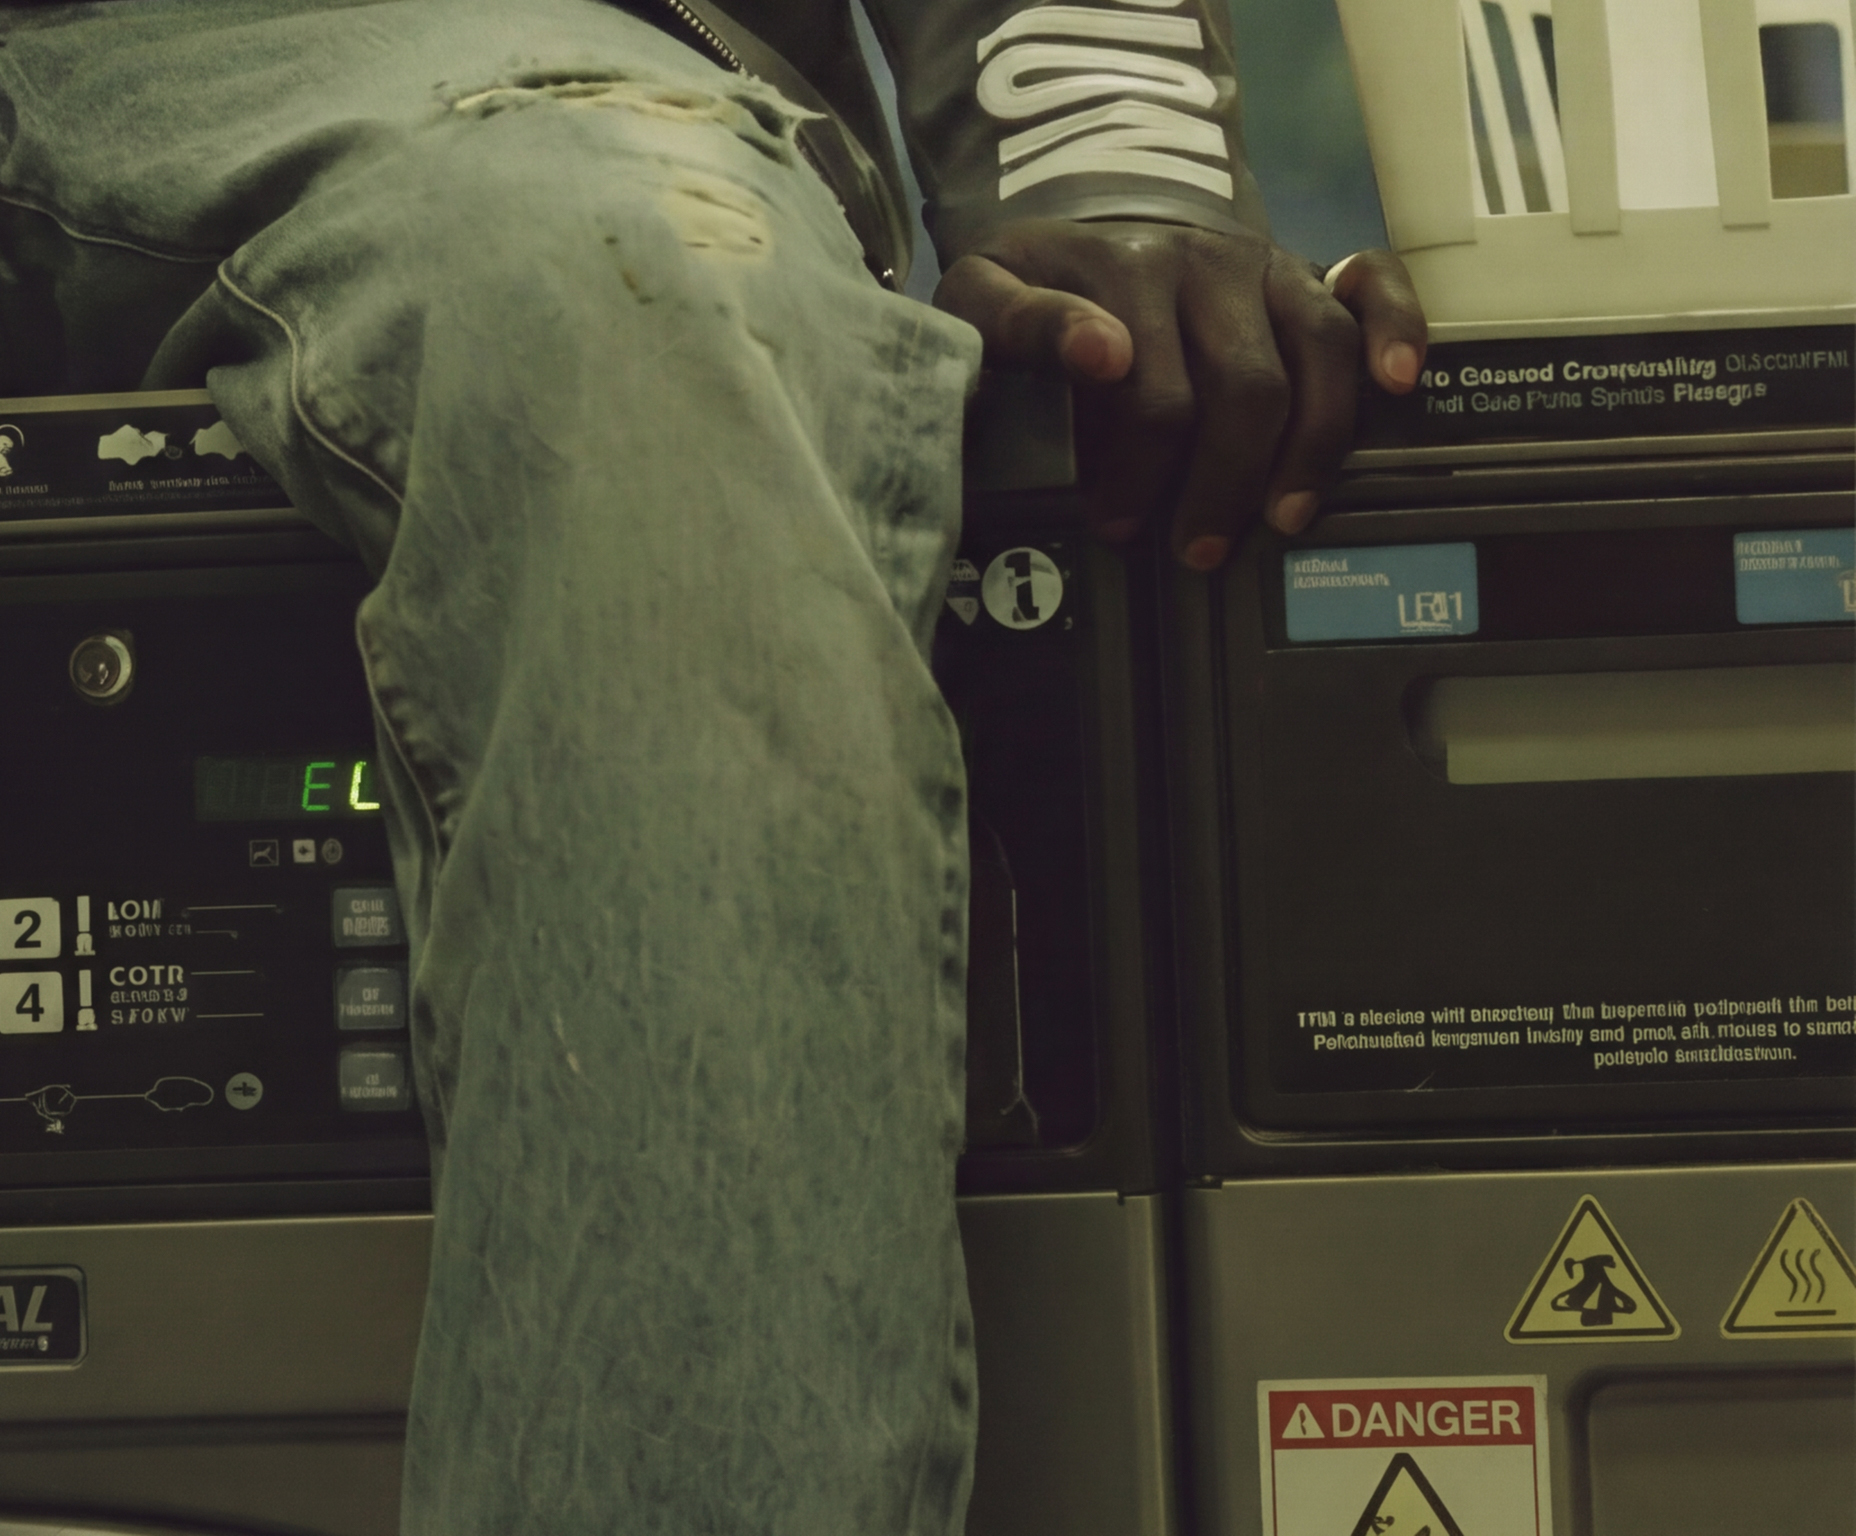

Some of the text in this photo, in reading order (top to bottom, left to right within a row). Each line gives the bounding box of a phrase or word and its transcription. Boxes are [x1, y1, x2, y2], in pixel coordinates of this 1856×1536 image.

[13, 909, 42, 949] 2
[15, 982, 45, 1023] 4
[1331, 1399, 1522, 1438] DANGER
